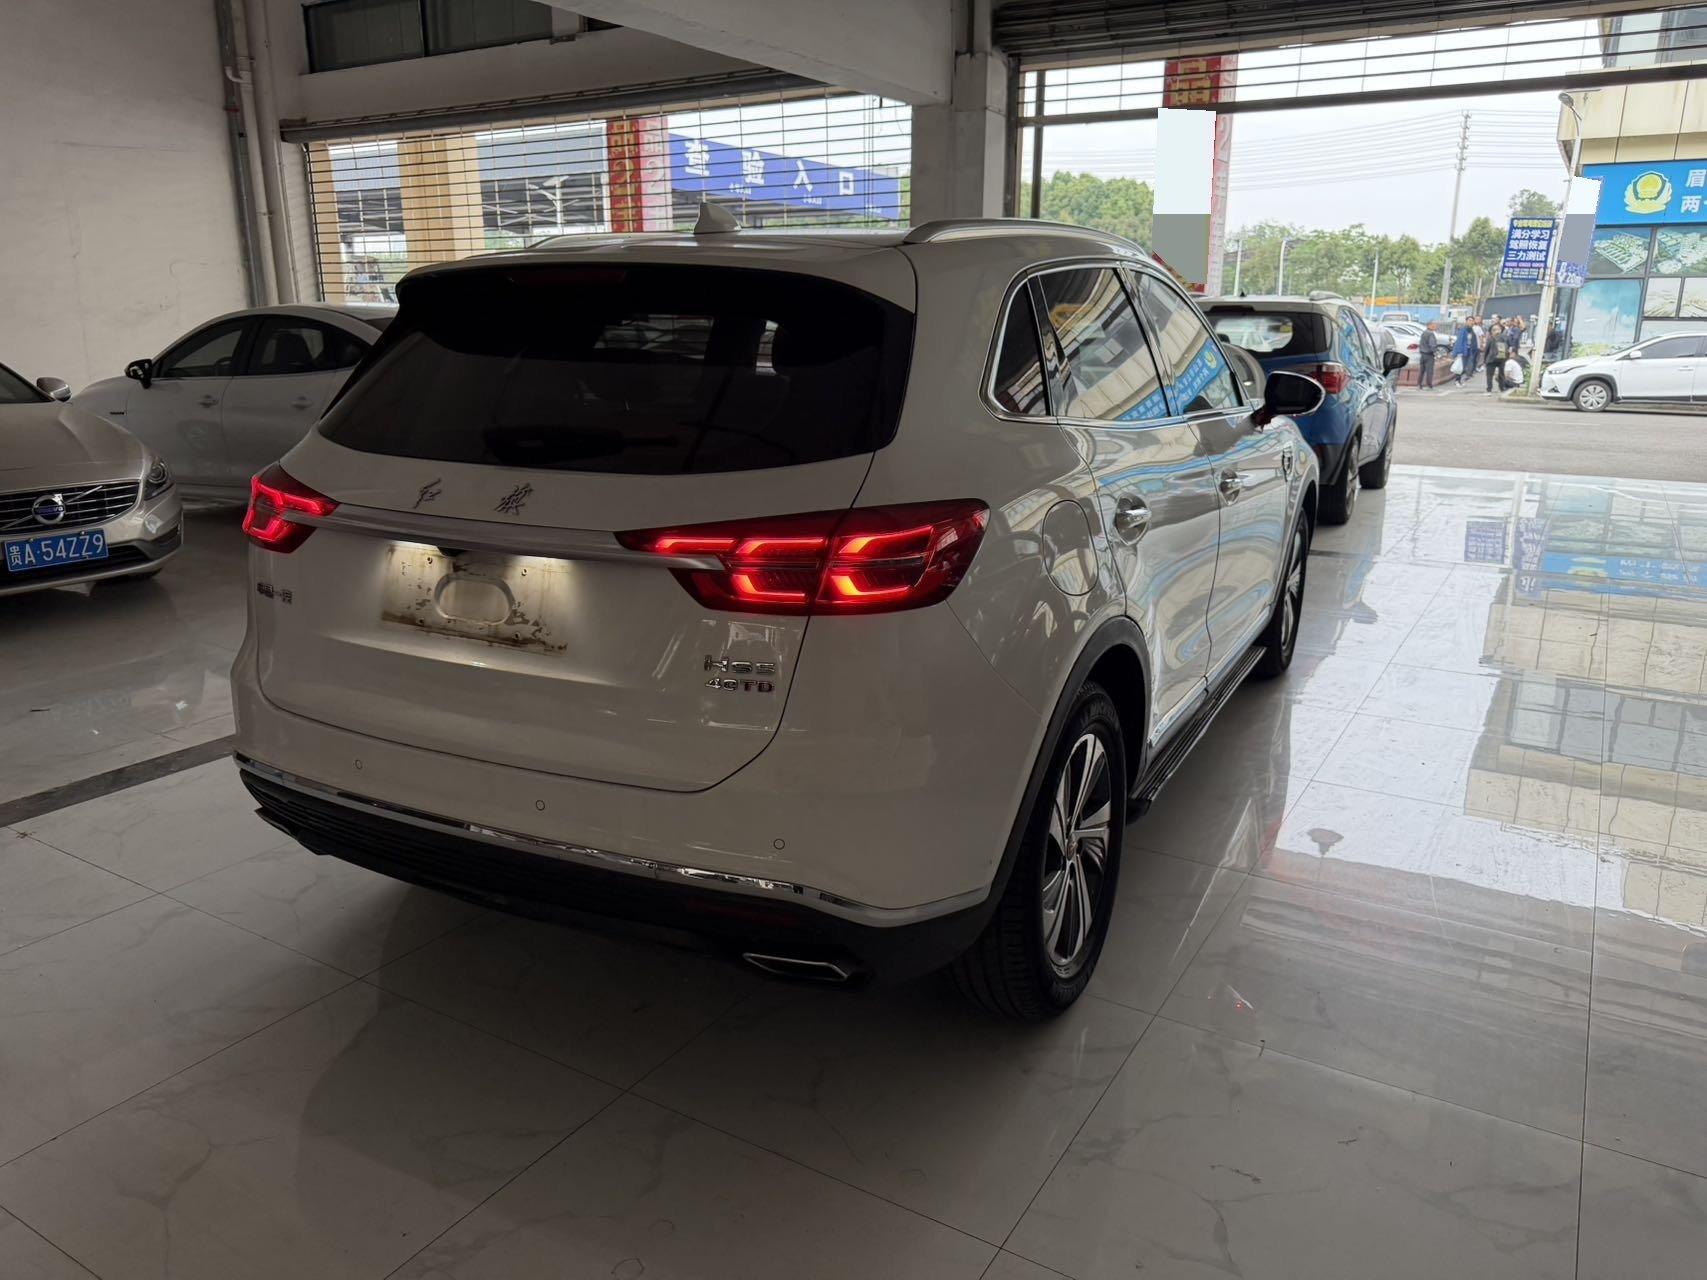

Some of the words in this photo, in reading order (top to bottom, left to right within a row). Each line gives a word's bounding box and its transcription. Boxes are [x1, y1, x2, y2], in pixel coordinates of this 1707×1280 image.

[1511, 228, 1550, 240] 满分学习
[1506, 250, 1546, 262] 三力测试
